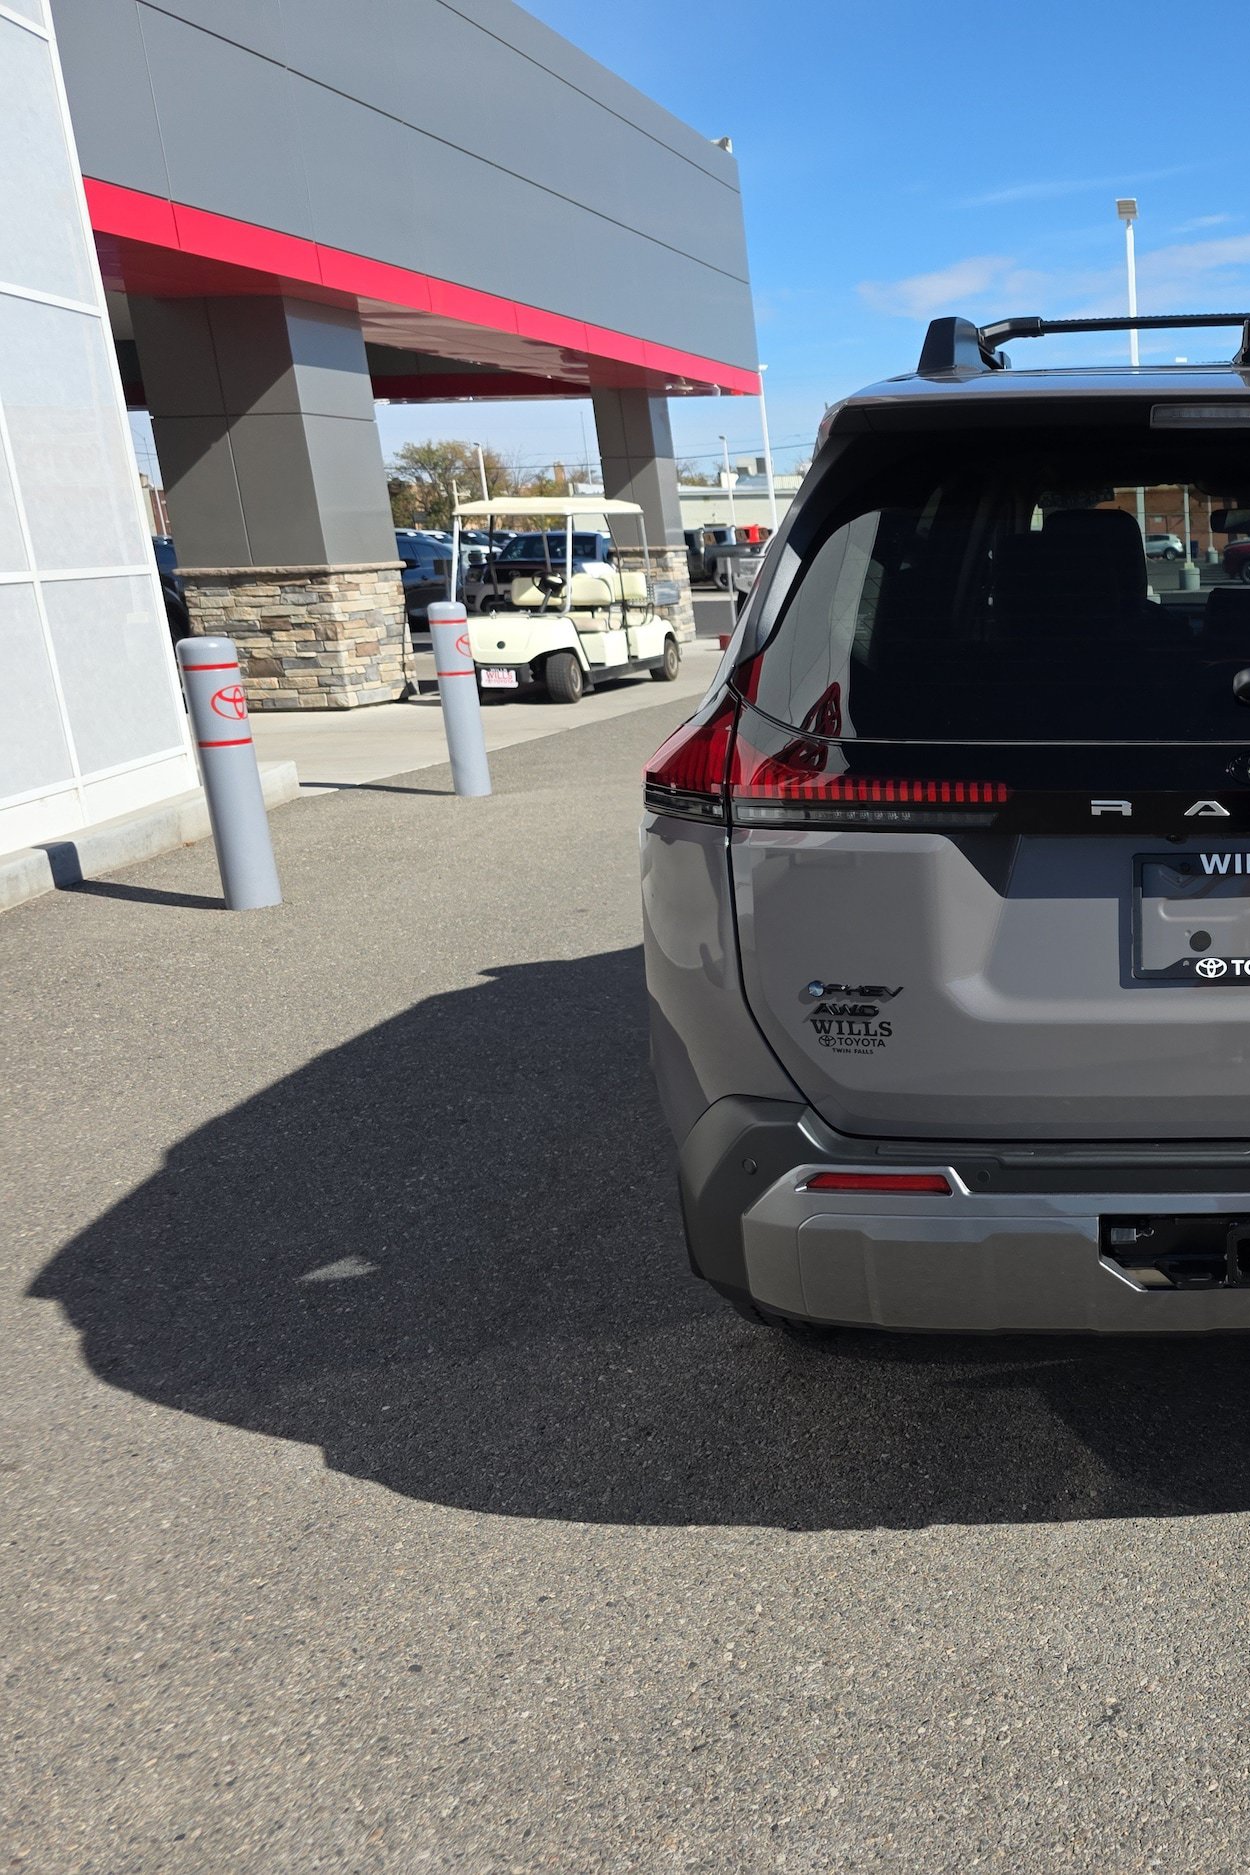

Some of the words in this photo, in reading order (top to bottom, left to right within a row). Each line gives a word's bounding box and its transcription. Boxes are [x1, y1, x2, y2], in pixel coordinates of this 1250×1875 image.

[485, 671, 513, 680] WILLS
[813, 1003, 880, 1017] AWD
[810, 1019, 893, 1038] WILLS
[837, 1037, 886, 1048] TOYOTA
